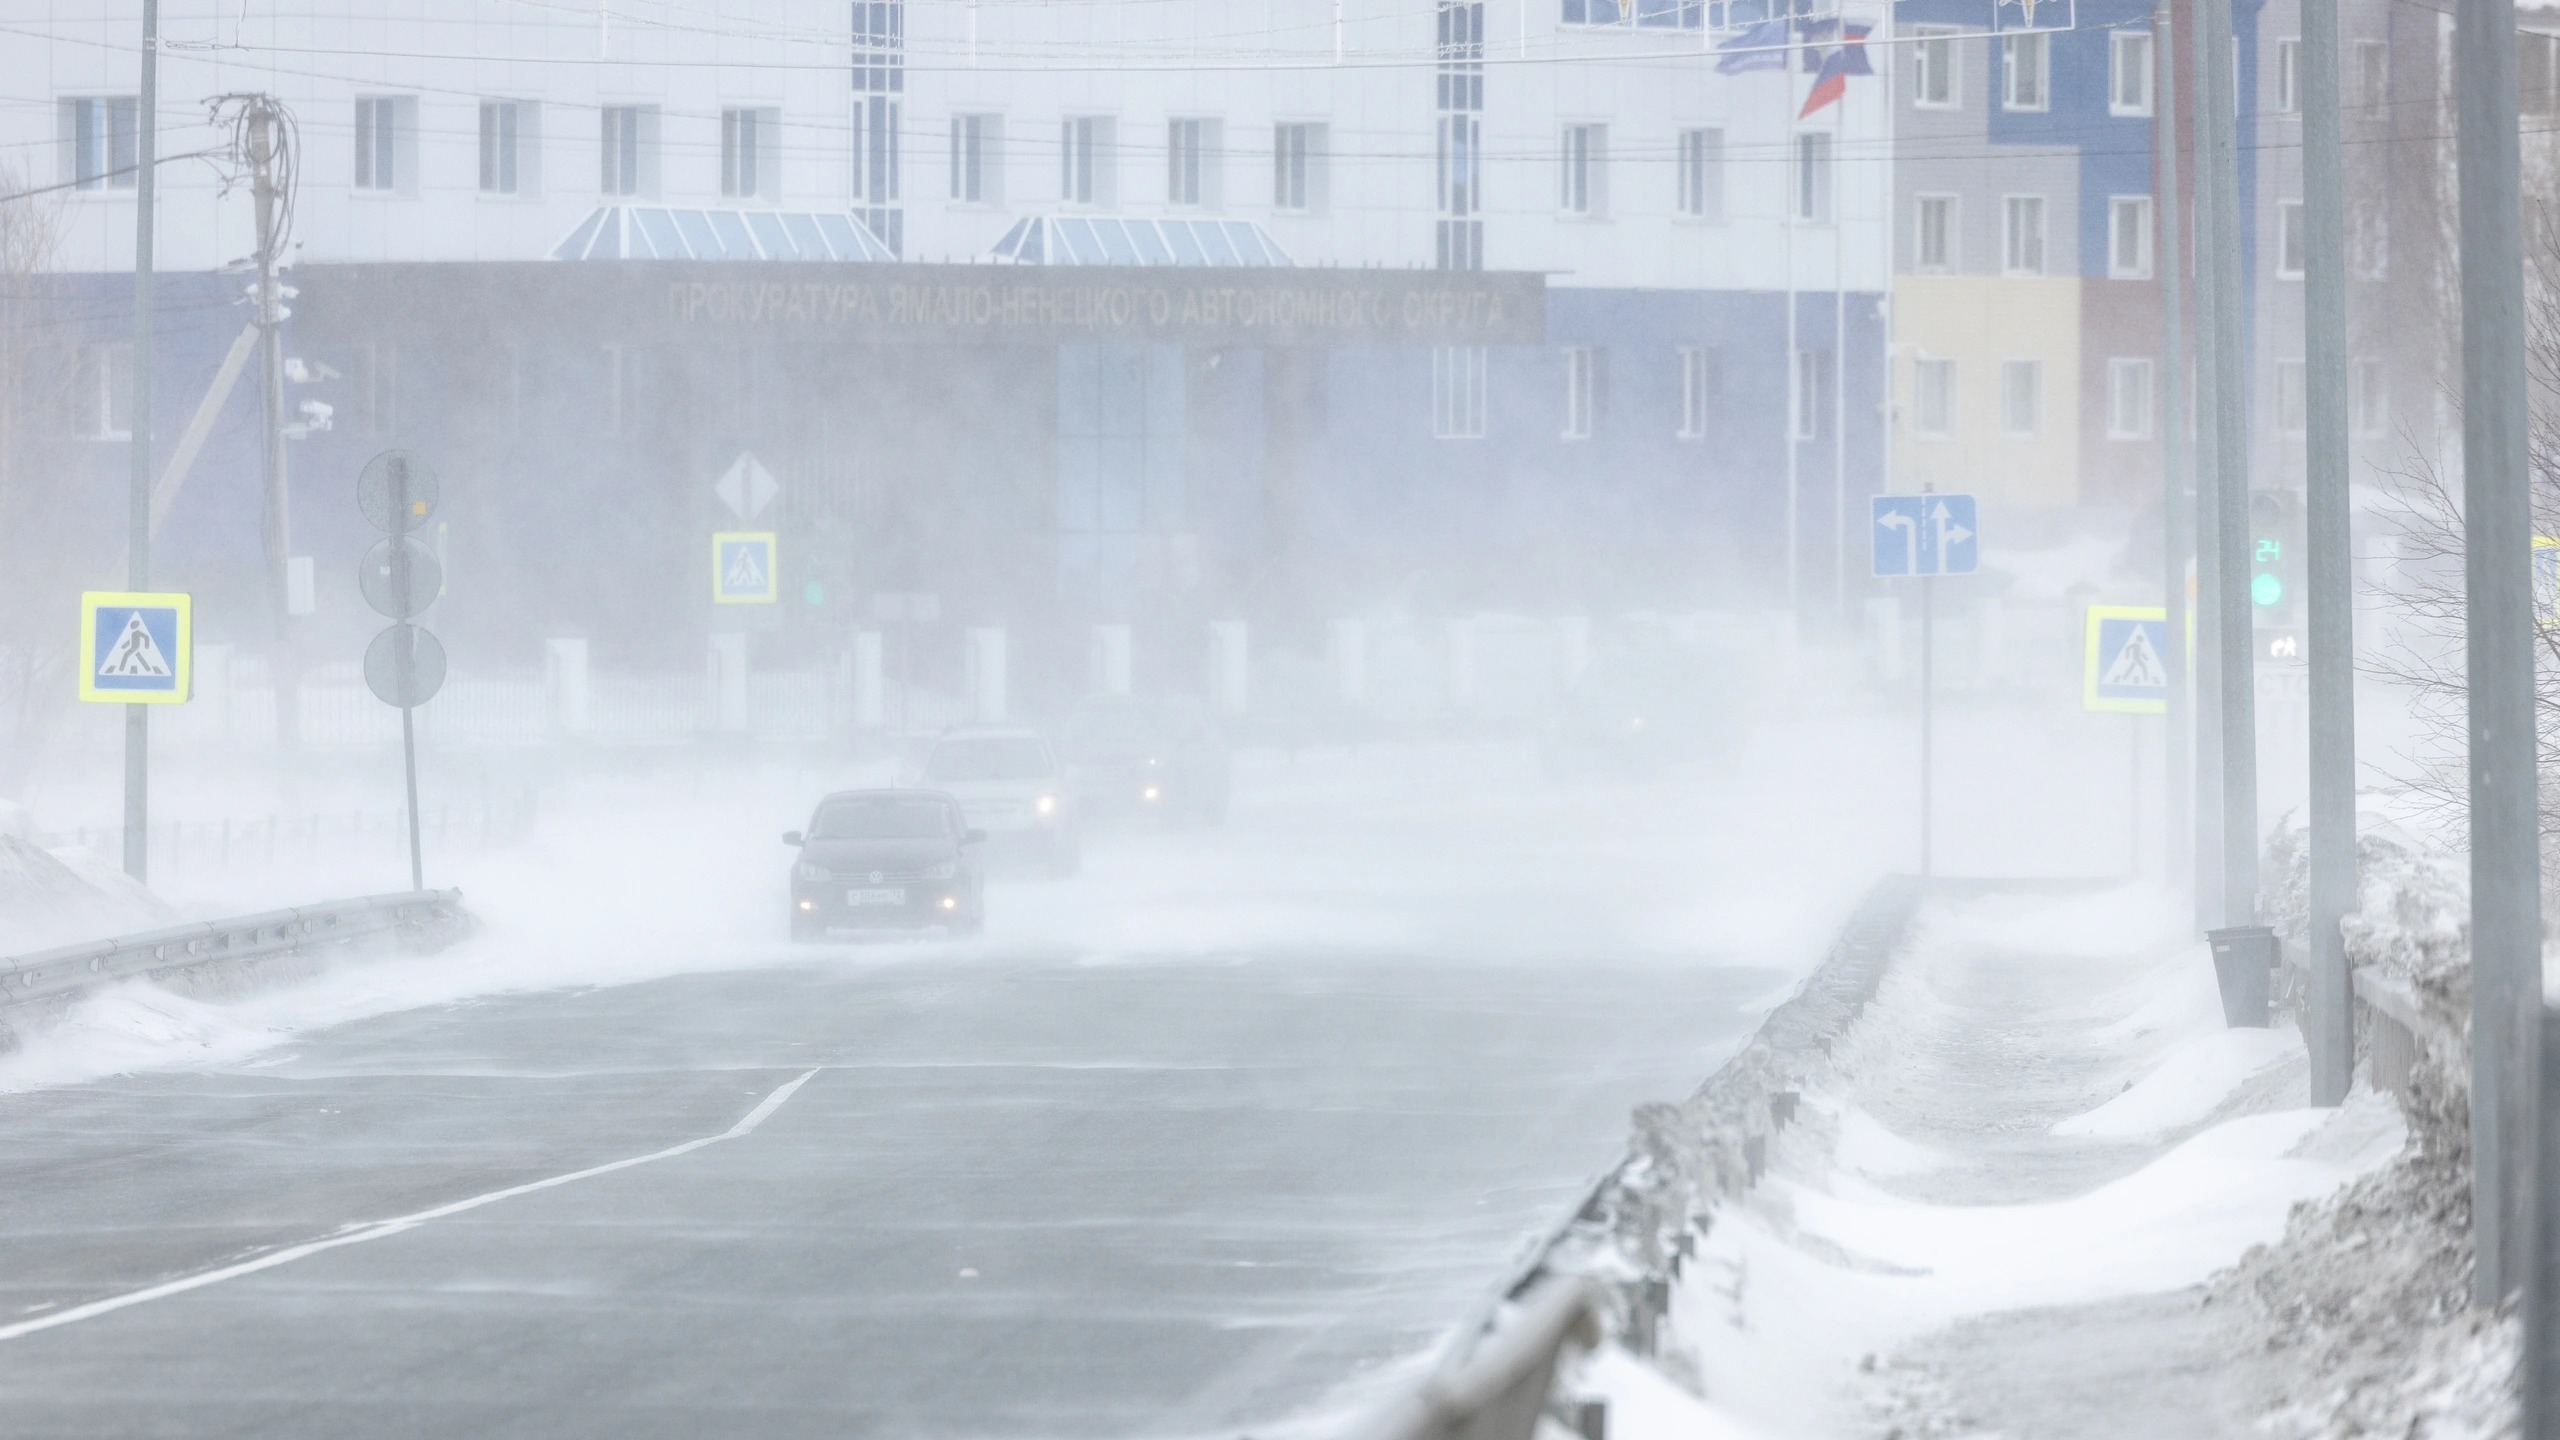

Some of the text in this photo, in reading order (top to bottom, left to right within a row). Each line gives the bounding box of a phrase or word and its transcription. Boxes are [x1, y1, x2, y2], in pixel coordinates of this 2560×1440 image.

[669, 282, 1504, 330] ПРОКУРАТУРА ЯМАЛО-НЕНЕЦКОГО АВТОНОМНОГО ОКРУГА
[2256, 539, 2280, 562] 24
[2256, 672, 2309, 698] СТО
